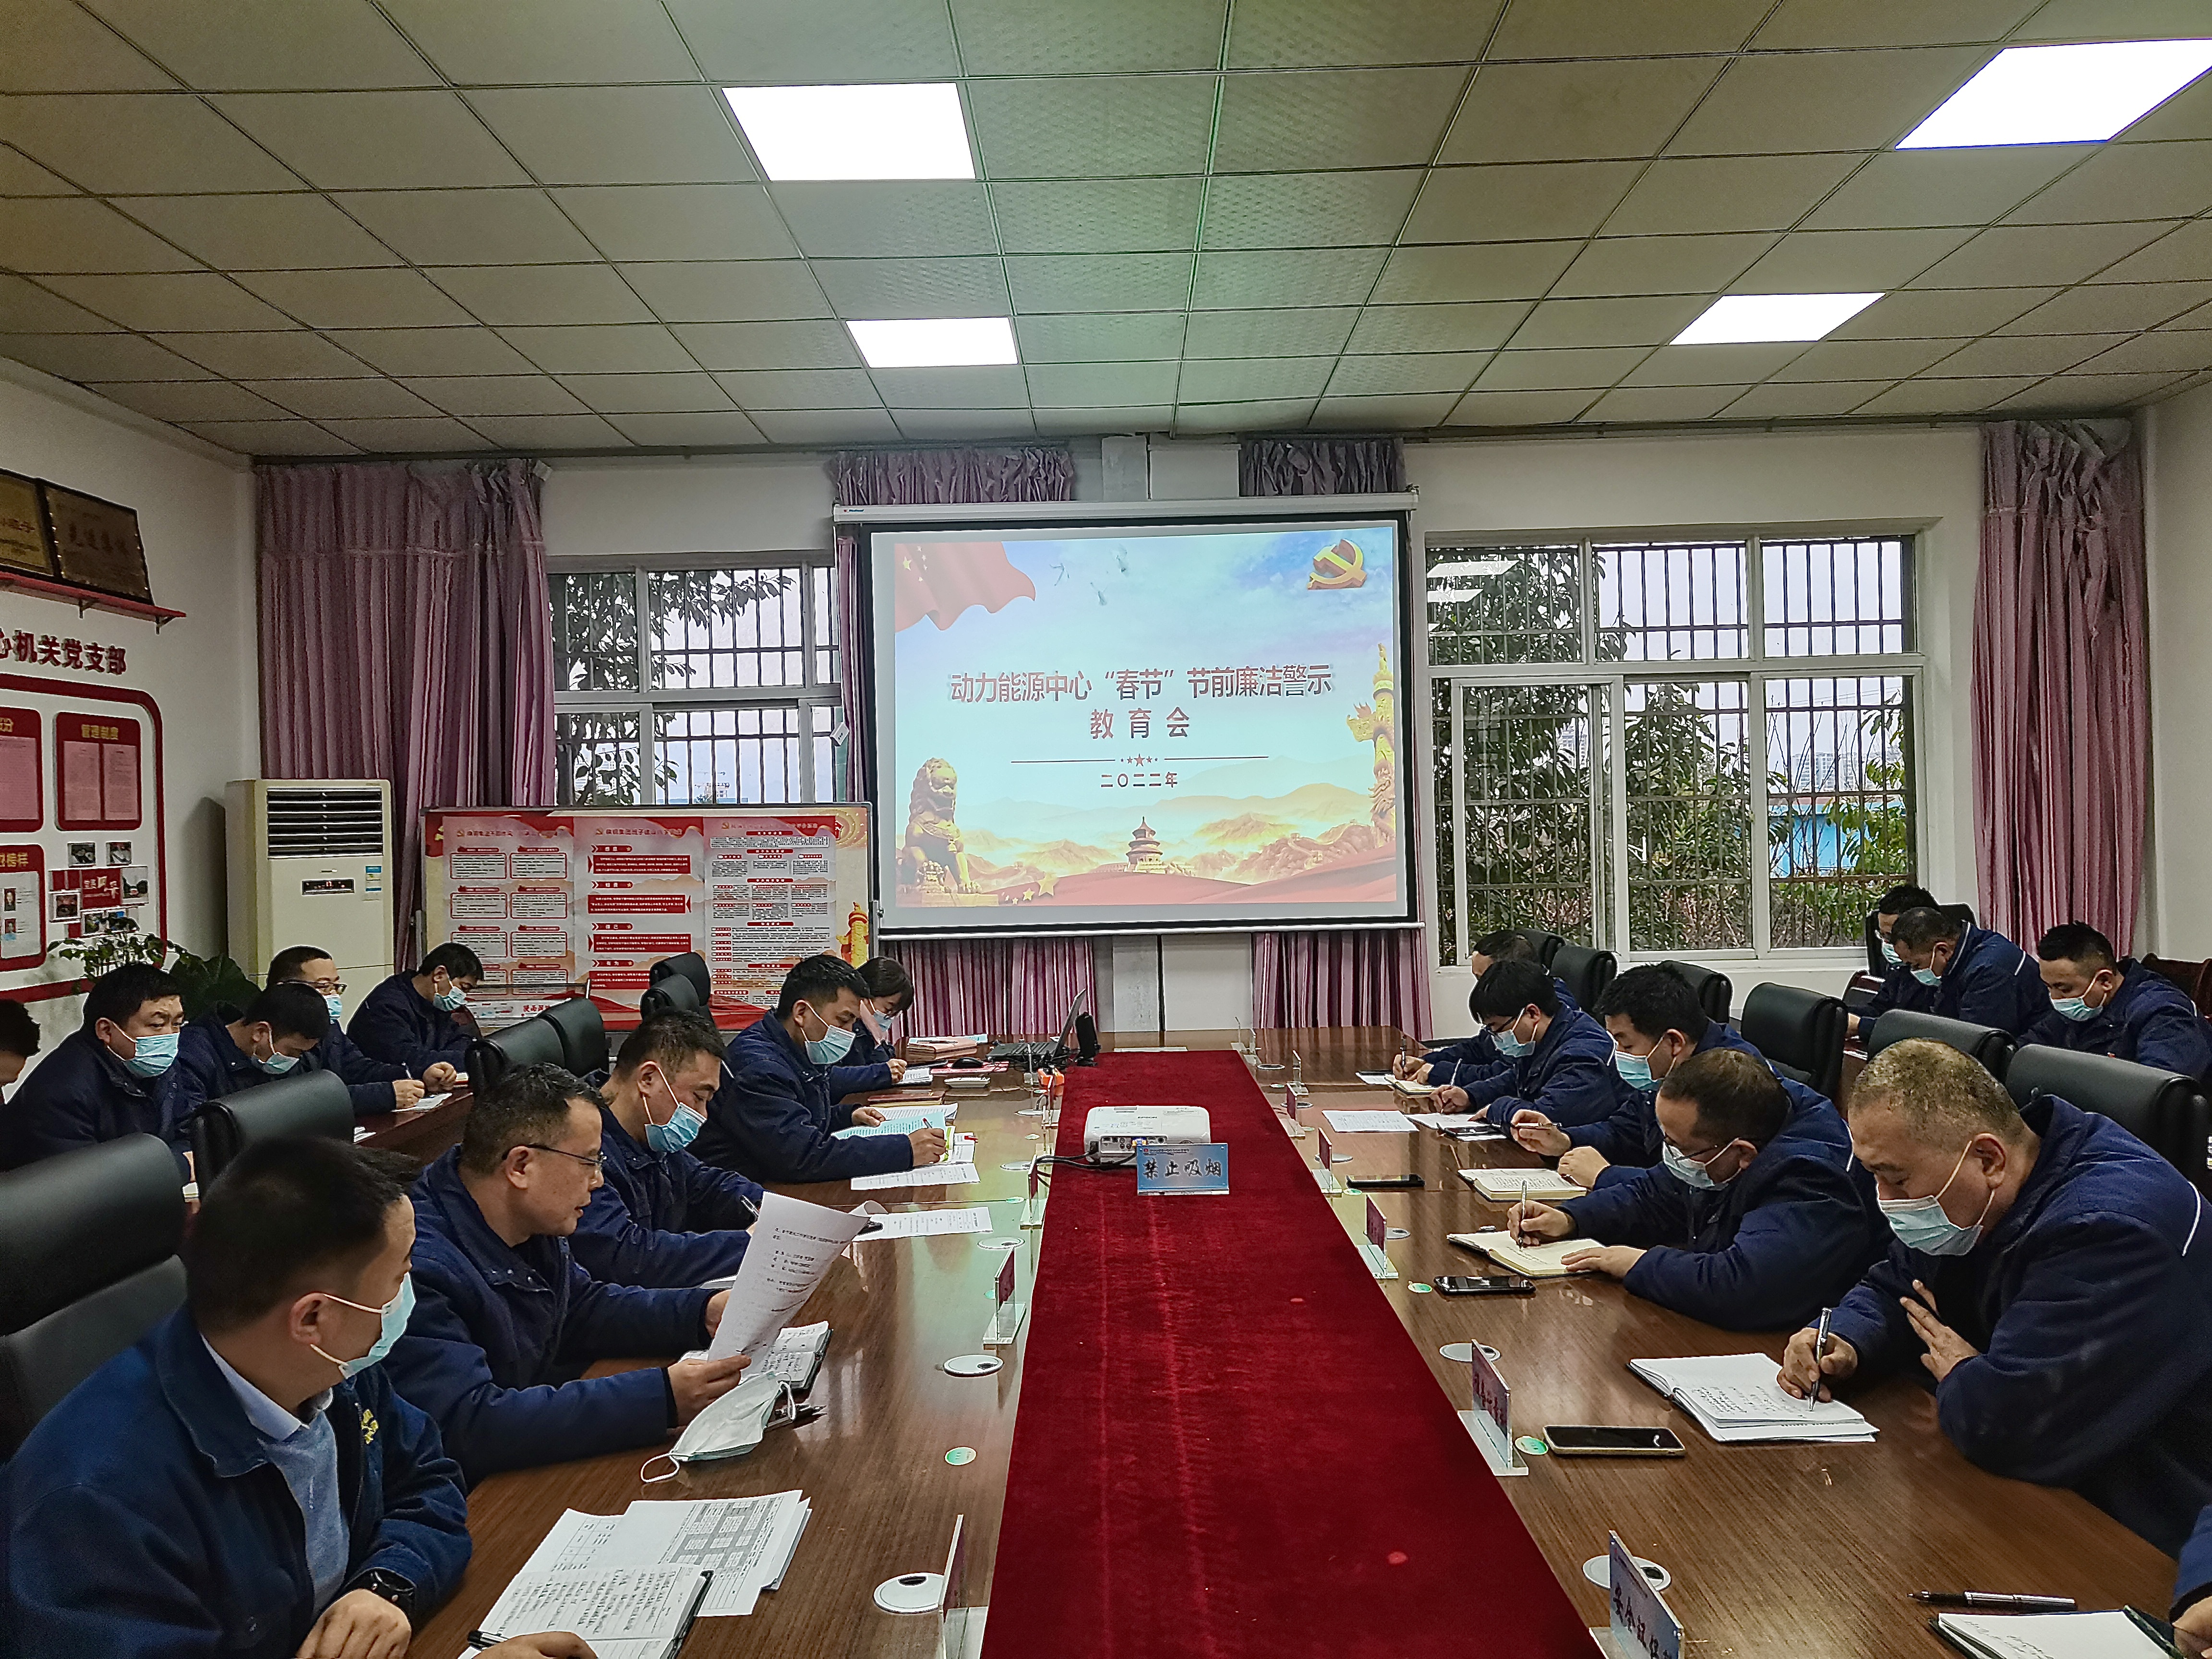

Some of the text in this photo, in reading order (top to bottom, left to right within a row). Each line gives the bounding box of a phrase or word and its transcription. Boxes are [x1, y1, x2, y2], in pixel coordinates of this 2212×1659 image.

[1090, 707, 1190, 739] 教育会
[1143, 1158, 1222, 1180] 禁止吸烟
